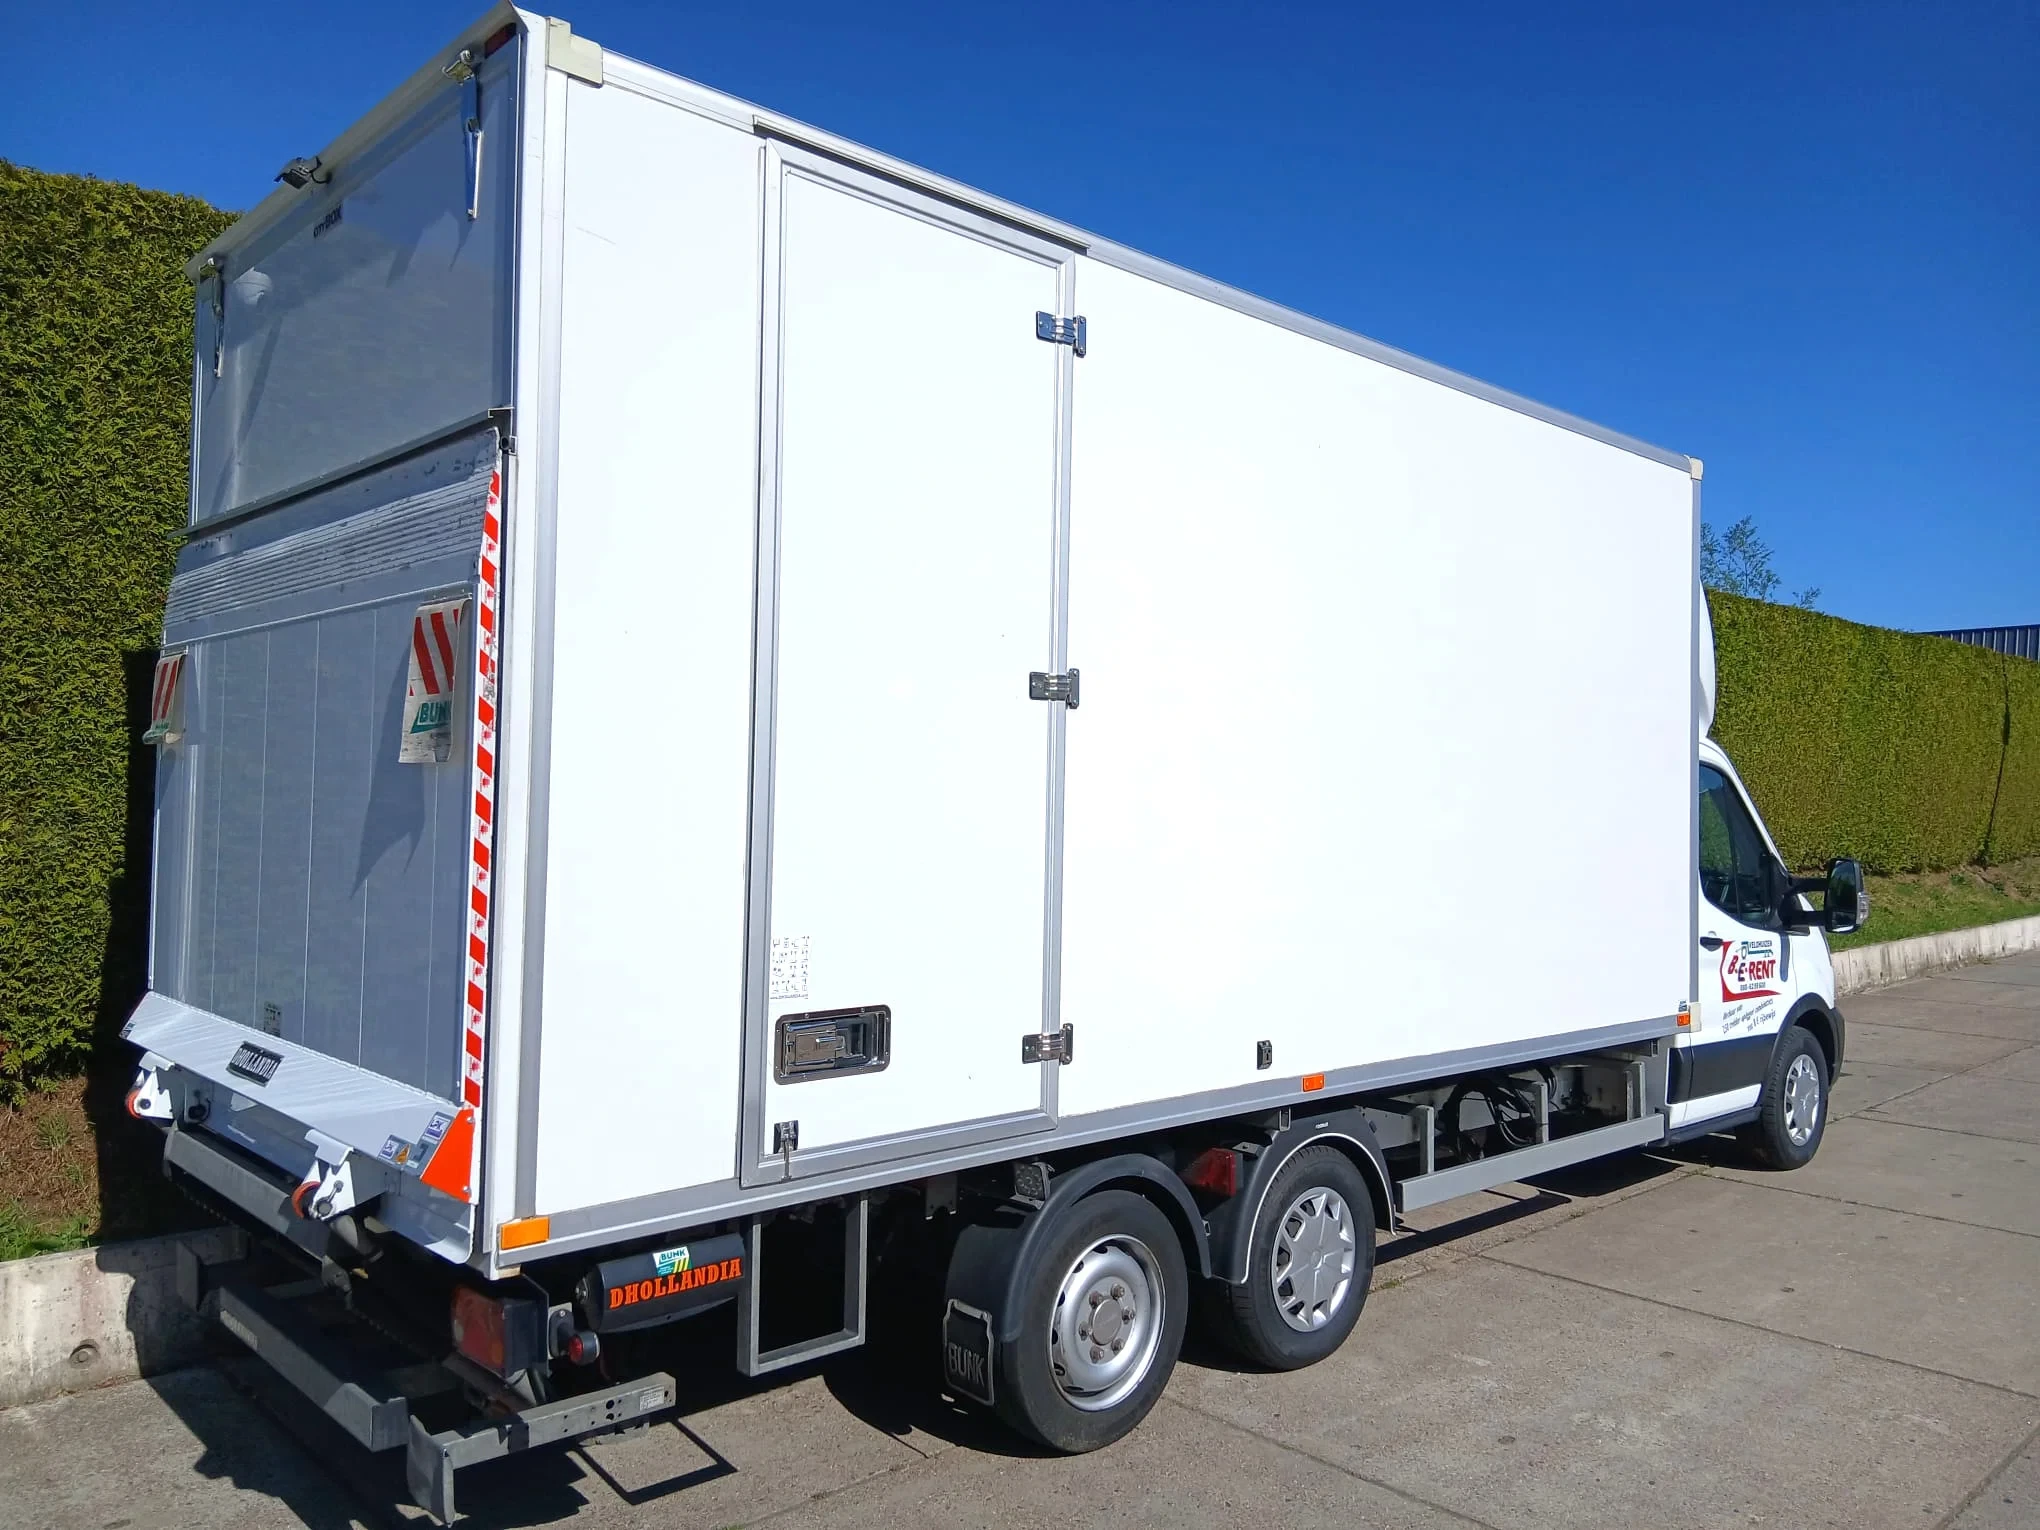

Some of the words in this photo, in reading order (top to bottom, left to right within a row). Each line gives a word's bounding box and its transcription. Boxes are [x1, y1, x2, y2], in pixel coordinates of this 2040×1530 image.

[661, 1249, 686, 1261] BUNK
[609, 1258, 742, 1309] DHOLLANDIA
[948, 1342, 985, 1388] BUNK
